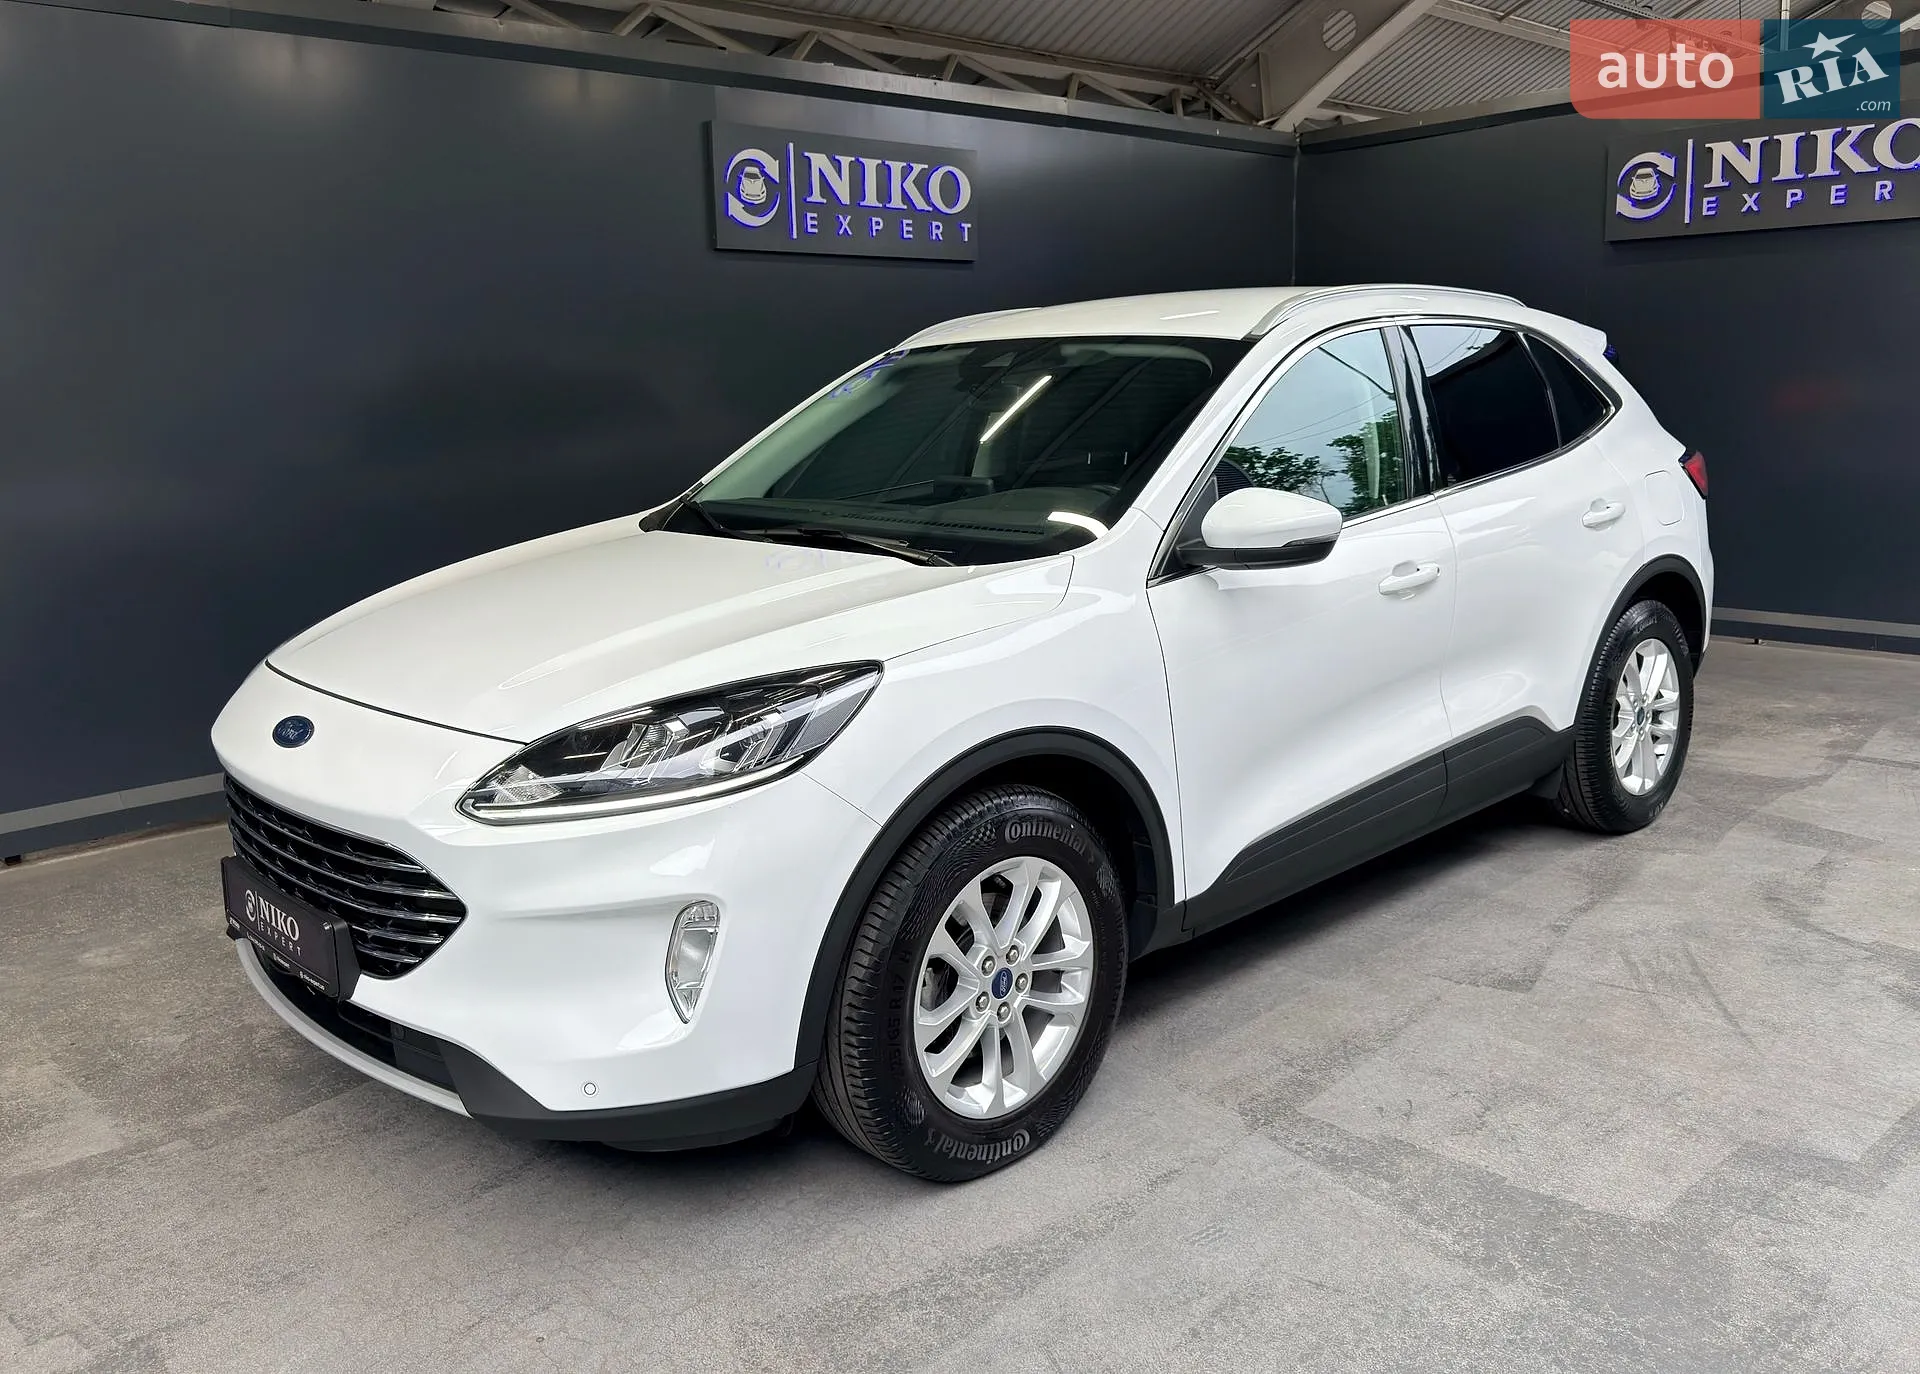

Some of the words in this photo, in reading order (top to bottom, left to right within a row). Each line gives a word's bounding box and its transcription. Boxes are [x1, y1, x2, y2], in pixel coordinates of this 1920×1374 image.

[1703, 117, 1920, 189] NIKO
[803, 152, 972, 215] NIKO
[804, 212, 973, 242] EXPERT
[1004, 818, 1089, 857] Continental
[258, 896, 300, 942] NIKO
[260, 921, 301, 957] EXPERT
[932, 1127, 1032, 1166] Continental
